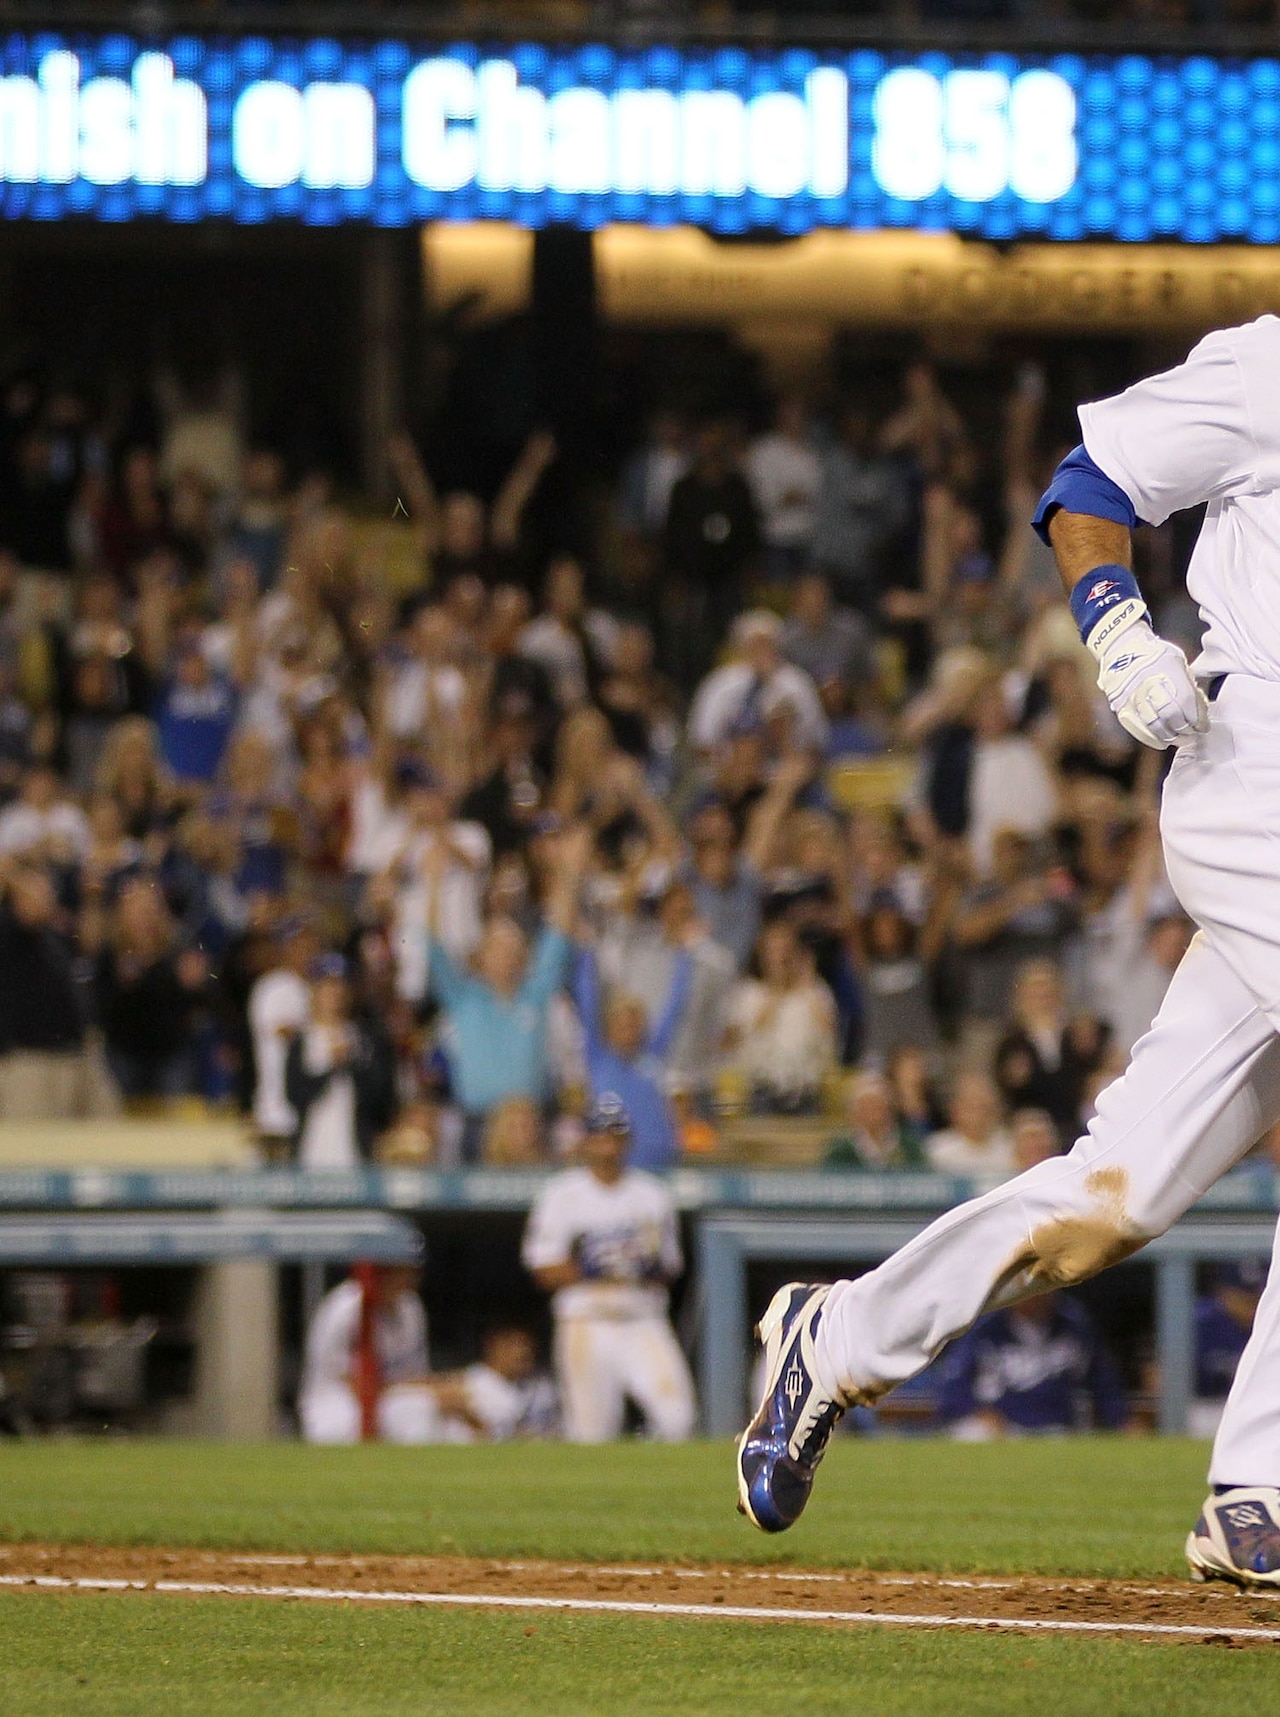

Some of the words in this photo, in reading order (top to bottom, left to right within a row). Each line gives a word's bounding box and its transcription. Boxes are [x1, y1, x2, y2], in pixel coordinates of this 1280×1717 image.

[232, 80, 377, 190] on
[402, 57, 850, 200] Channel
[870, 66, 1080, 204] 858
[1093, 601, 1136, 650] EASTON
